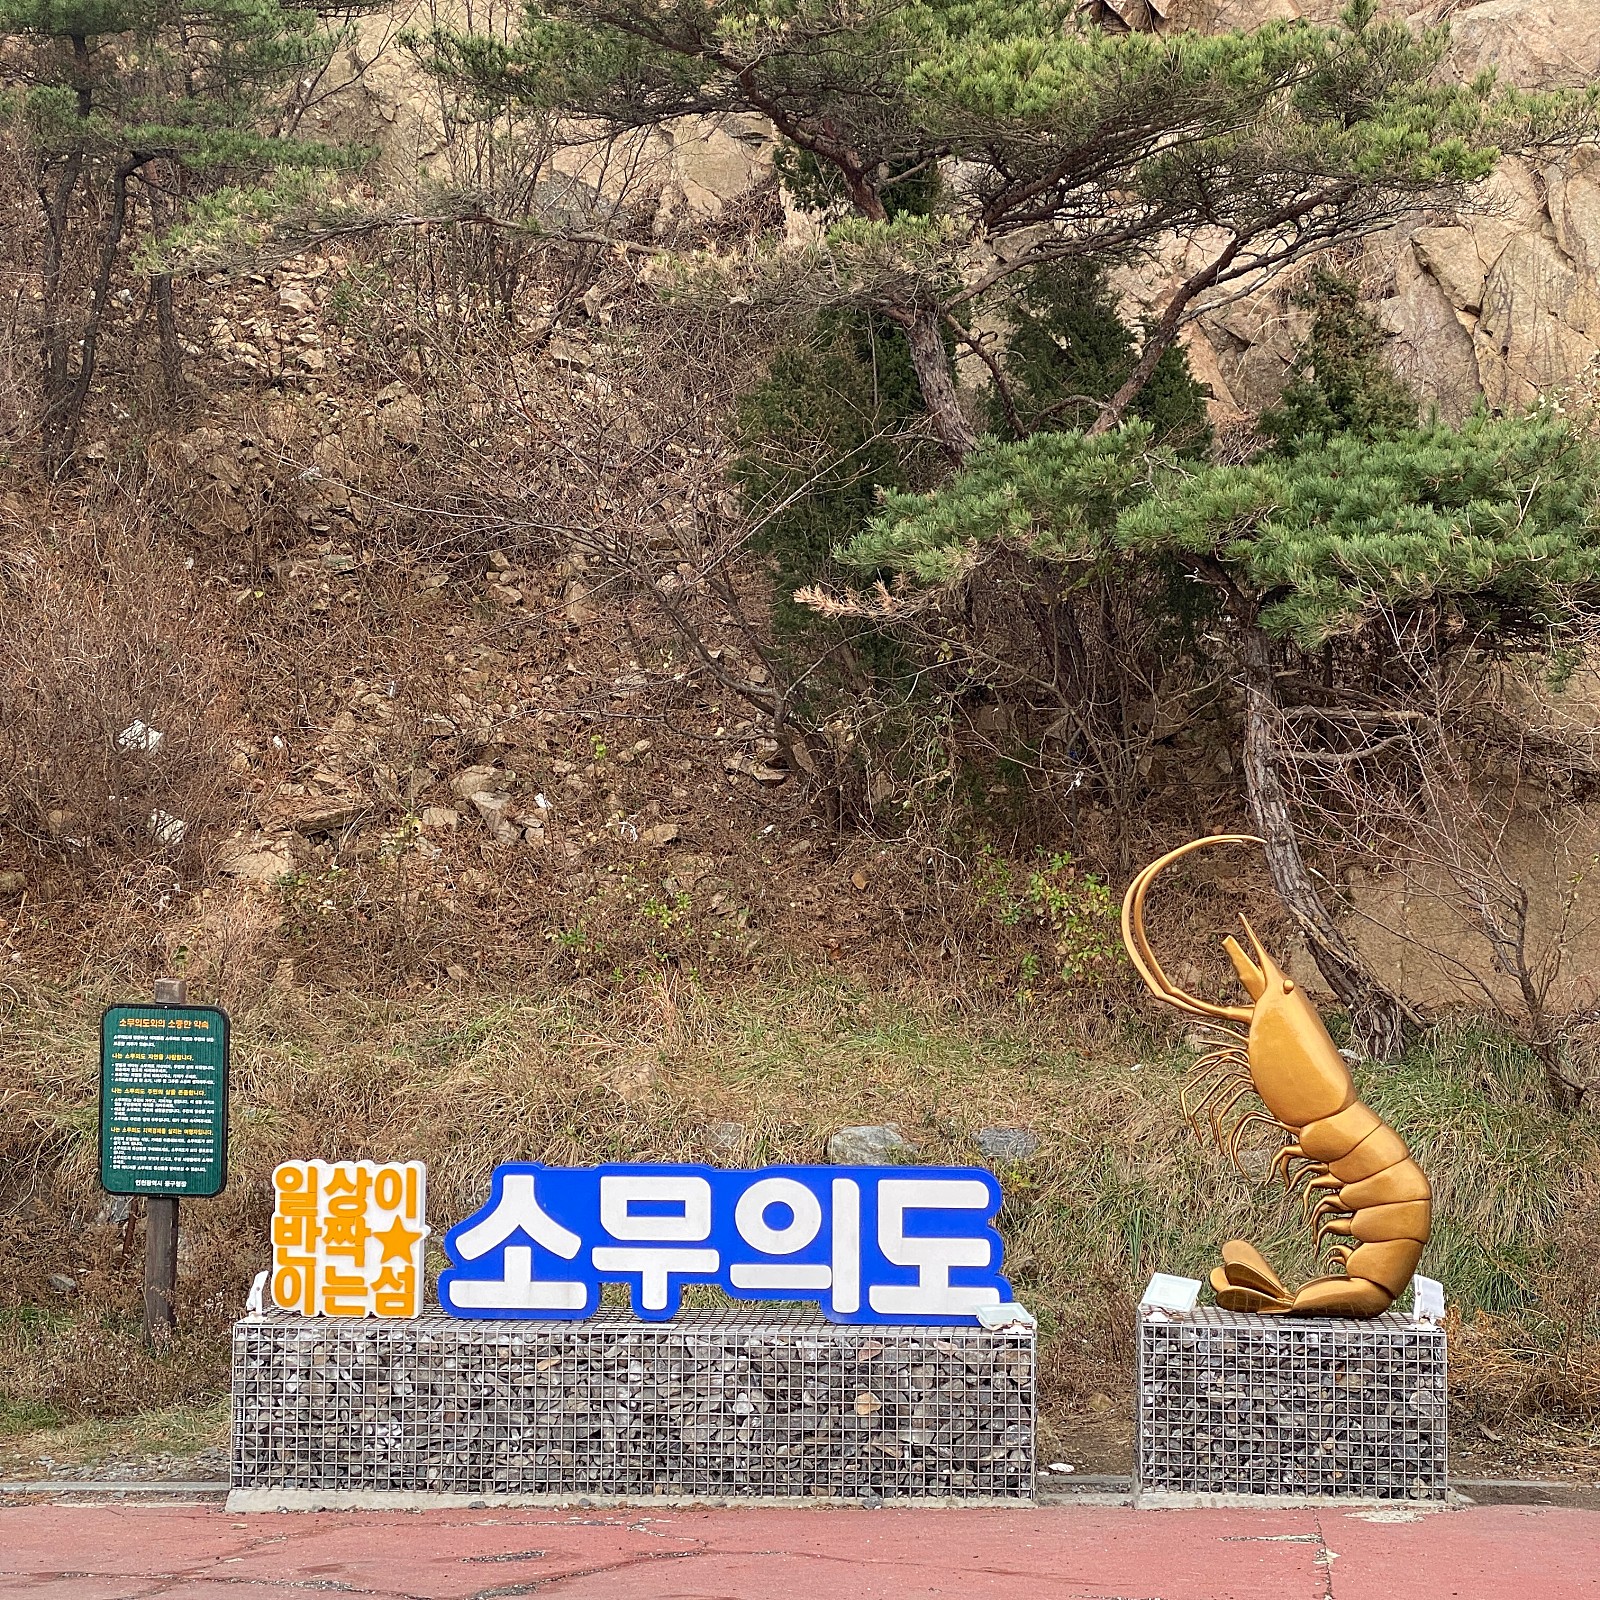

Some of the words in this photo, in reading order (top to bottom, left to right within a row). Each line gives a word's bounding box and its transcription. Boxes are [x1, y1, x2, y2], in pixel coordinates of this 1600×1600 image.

[275, 1166, 417, 1219] 일상이
[274, 1216, 371, 1267] 반짝
[448, 1174, 1001, 1316] 소무의도
